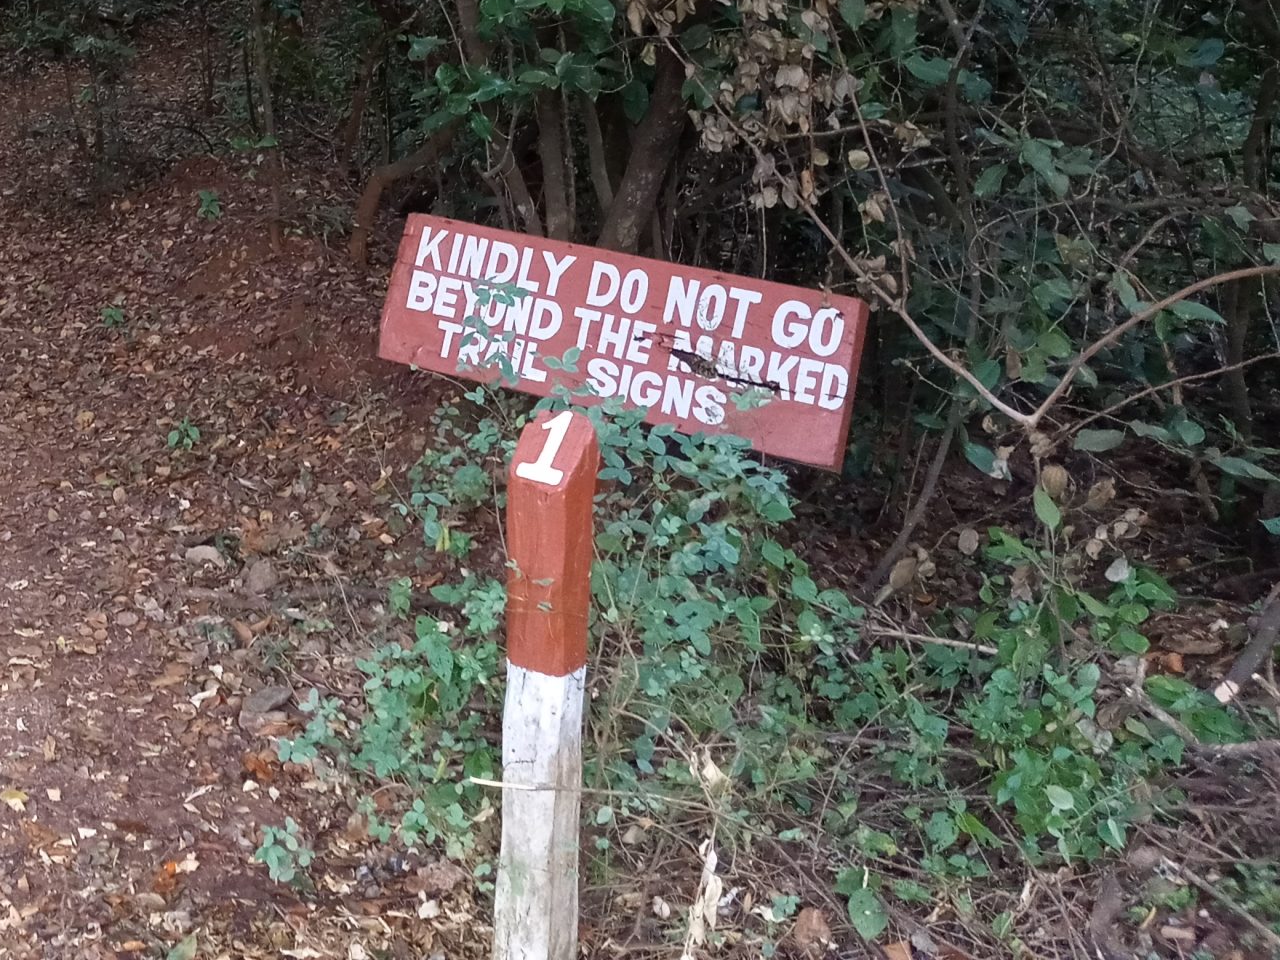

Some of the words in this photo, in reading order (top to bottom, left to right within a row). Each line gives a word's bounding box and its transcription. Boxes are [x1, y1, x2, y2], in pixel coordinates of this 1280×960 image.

[406, 270, 563, 341] BEYOND
[574, 307, 656, 365] THE
[415, 226, 577, 296] KINDLY
[586, 261, 649, 314] DO
[663, 276, 763, 338] NOT
[771, 301, 844, 357] GO
[437, 320, 547, 382] TRAIL
[586, 364, 726, 425] SIGNS
[515, 411, 574, 486] 1
